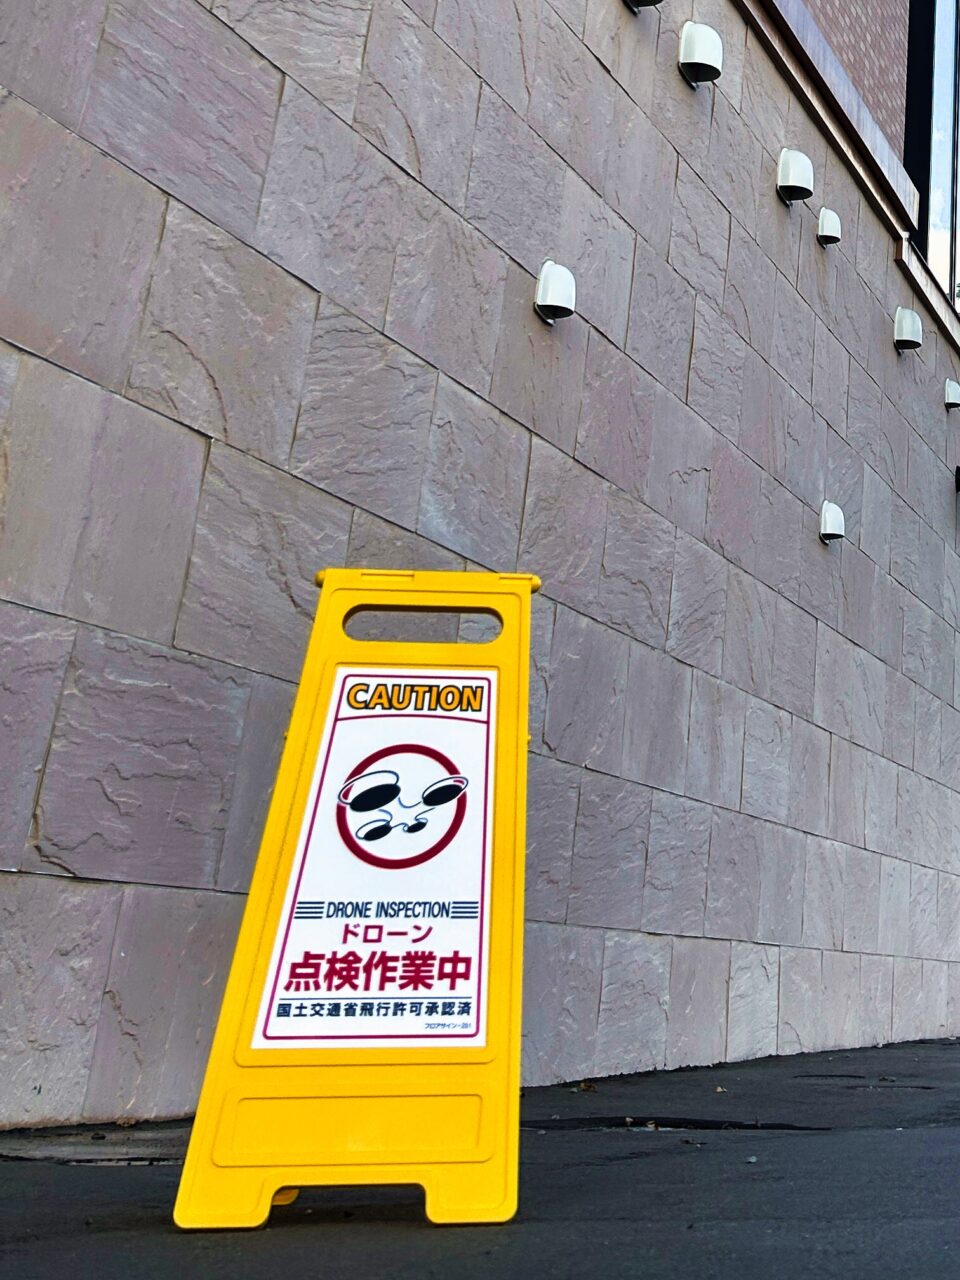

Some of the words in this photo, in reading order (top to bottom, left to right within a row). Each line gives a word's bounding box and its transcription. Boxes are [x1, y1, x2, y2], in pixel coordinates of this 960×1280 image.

[347, 683, 484, 712] CAUTION
[326, 901, 373, 918] DRONE
[375, 901, 451, 918] INSPECTION
[342, 923, 432, 944] ドローン
[284, 950, 472, 991] 点検作業中
[276, 1001, 472, 1017] 国土交通省飛行許可承認済
